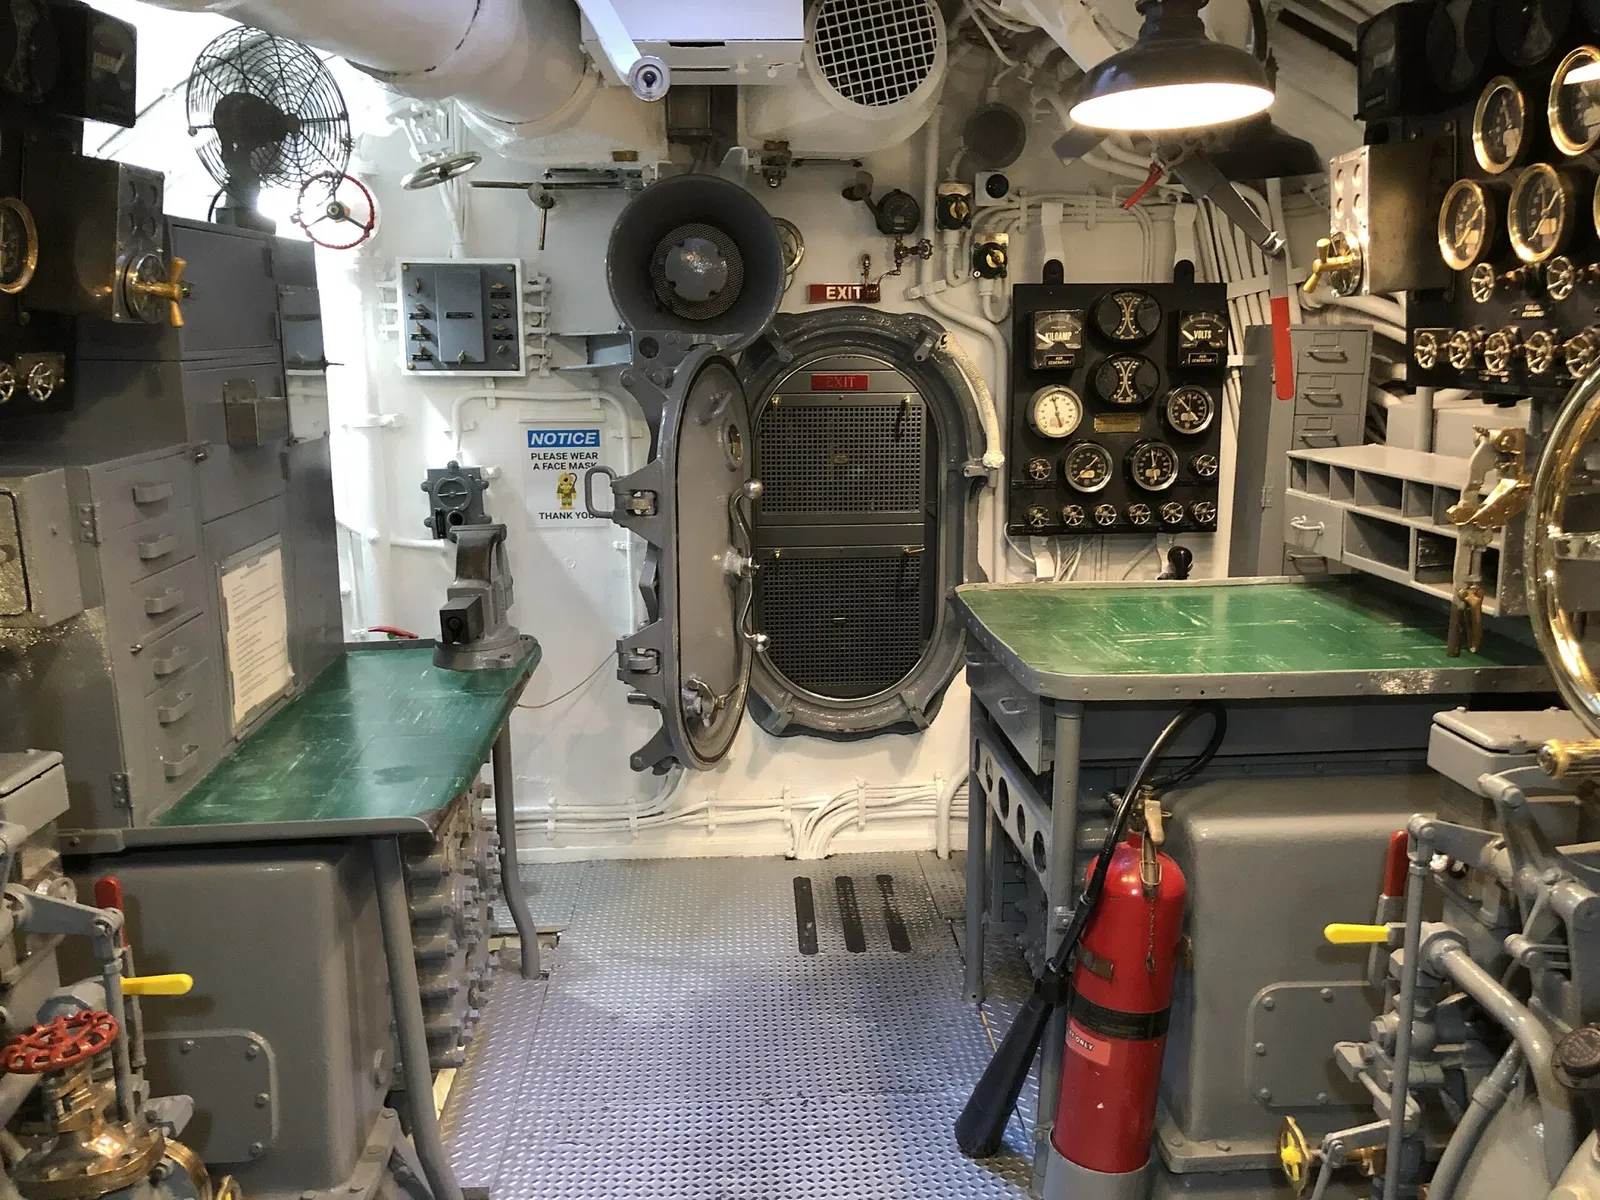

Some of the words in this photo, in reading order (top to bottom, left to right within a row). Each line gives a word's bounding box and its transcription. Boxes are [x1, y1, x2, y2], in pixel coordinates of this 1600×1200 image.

[826, 286, 863, 300] EXIT
[1193, 329, 1212, 340] VOLTS
[826, 376, 856, 388] EXIT
[530, 432, 597, 446] NOTICE
[530, 452, 568, 461] PLEASE
[570, 452, 599, 460] WEAR
[533, 462, 541, 471] A
[542, 462, 567, 470] FACE
[568, 461, 598, 470] MASK
[538, 511, 573, 520] THANK
